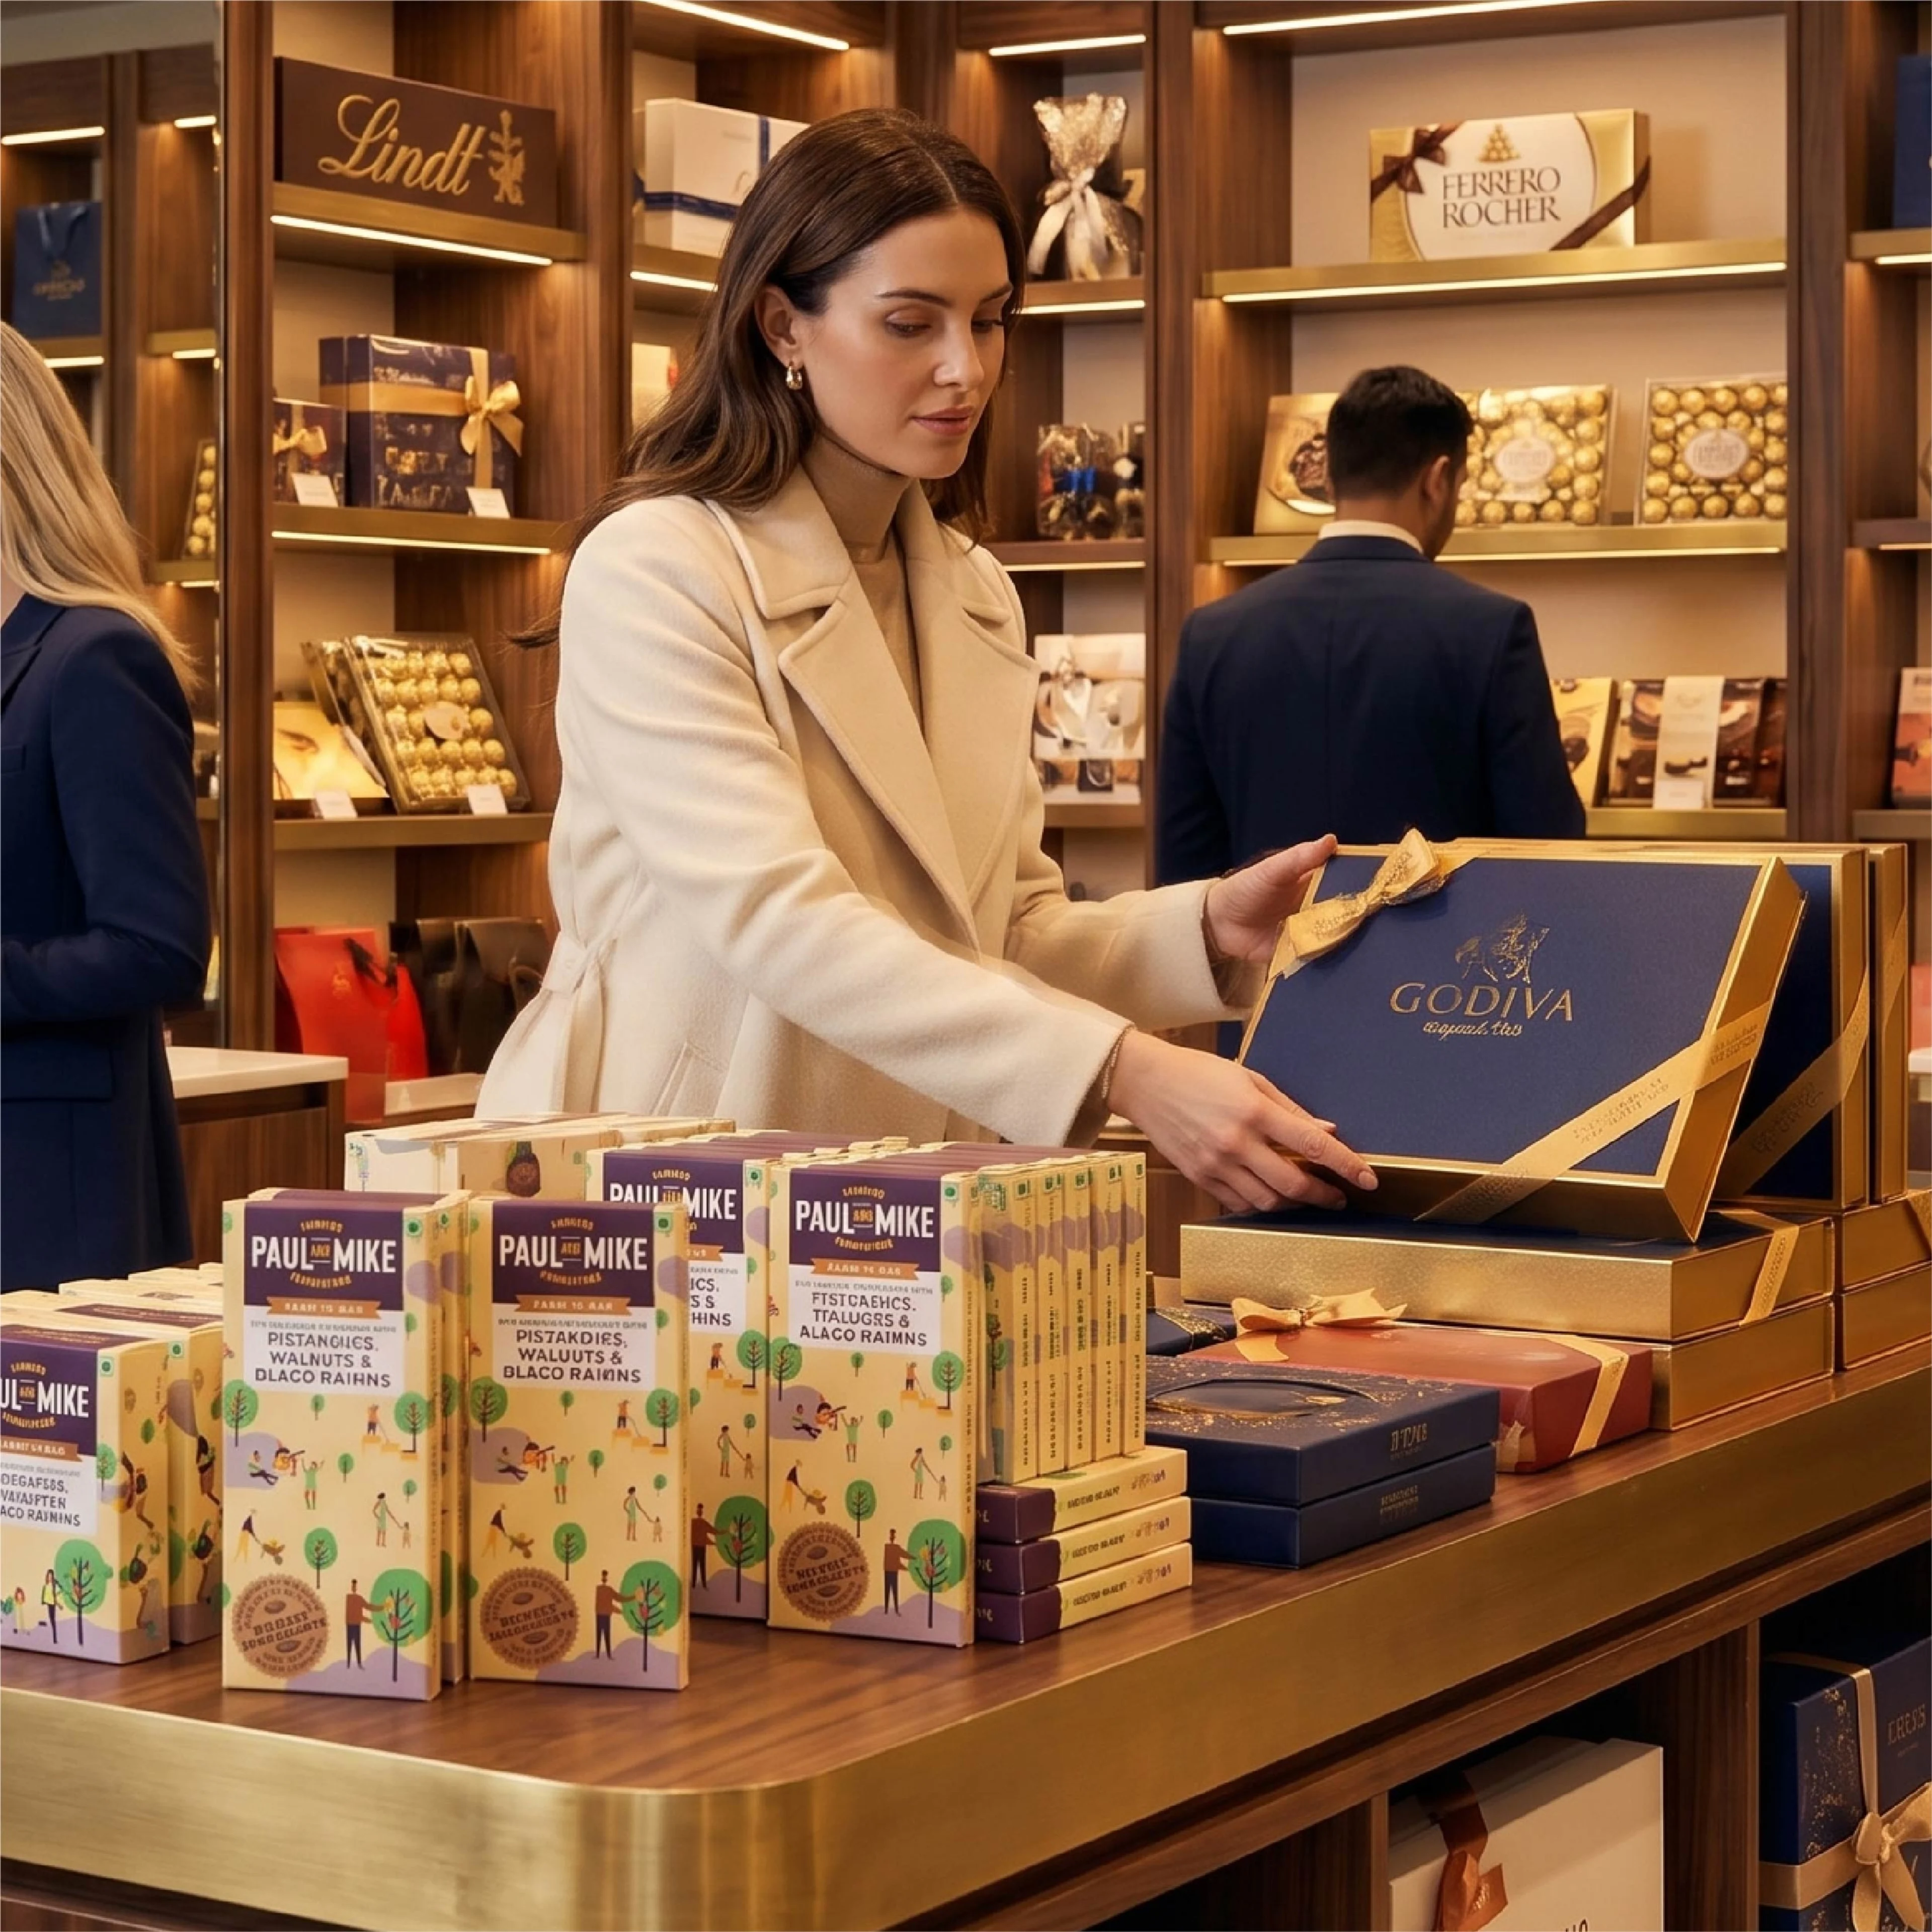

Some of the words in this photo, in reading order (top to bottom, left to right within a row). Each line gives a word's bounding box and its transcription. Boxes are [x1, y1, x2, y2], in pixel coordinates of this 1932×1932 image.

[318, 95, 487, 195] Lindt
[1442, 167, 1561, 199] FERRERO
[1442, 196, 1561, 228] ROCHER
[1390, 982, 1573, 1021] GODIVA
[683, 1187, 737, 1220] MIKE
[795, 1200, 854, 1234] PAUL
[875, 1203, 934, 1238] MIKE
[252, 1235, 314, 1270] PAUL
[333, 1238, 396, 1272] MIKE
[499, 1235, 563, 1268] PAUL
[584, 1236, 648, 1270] MIKE
[269, 1351, 354, 1368] WALNUTS
[0, 1377, 22, 1411] UL
[37, 1381, 89, 1418] MIKE
